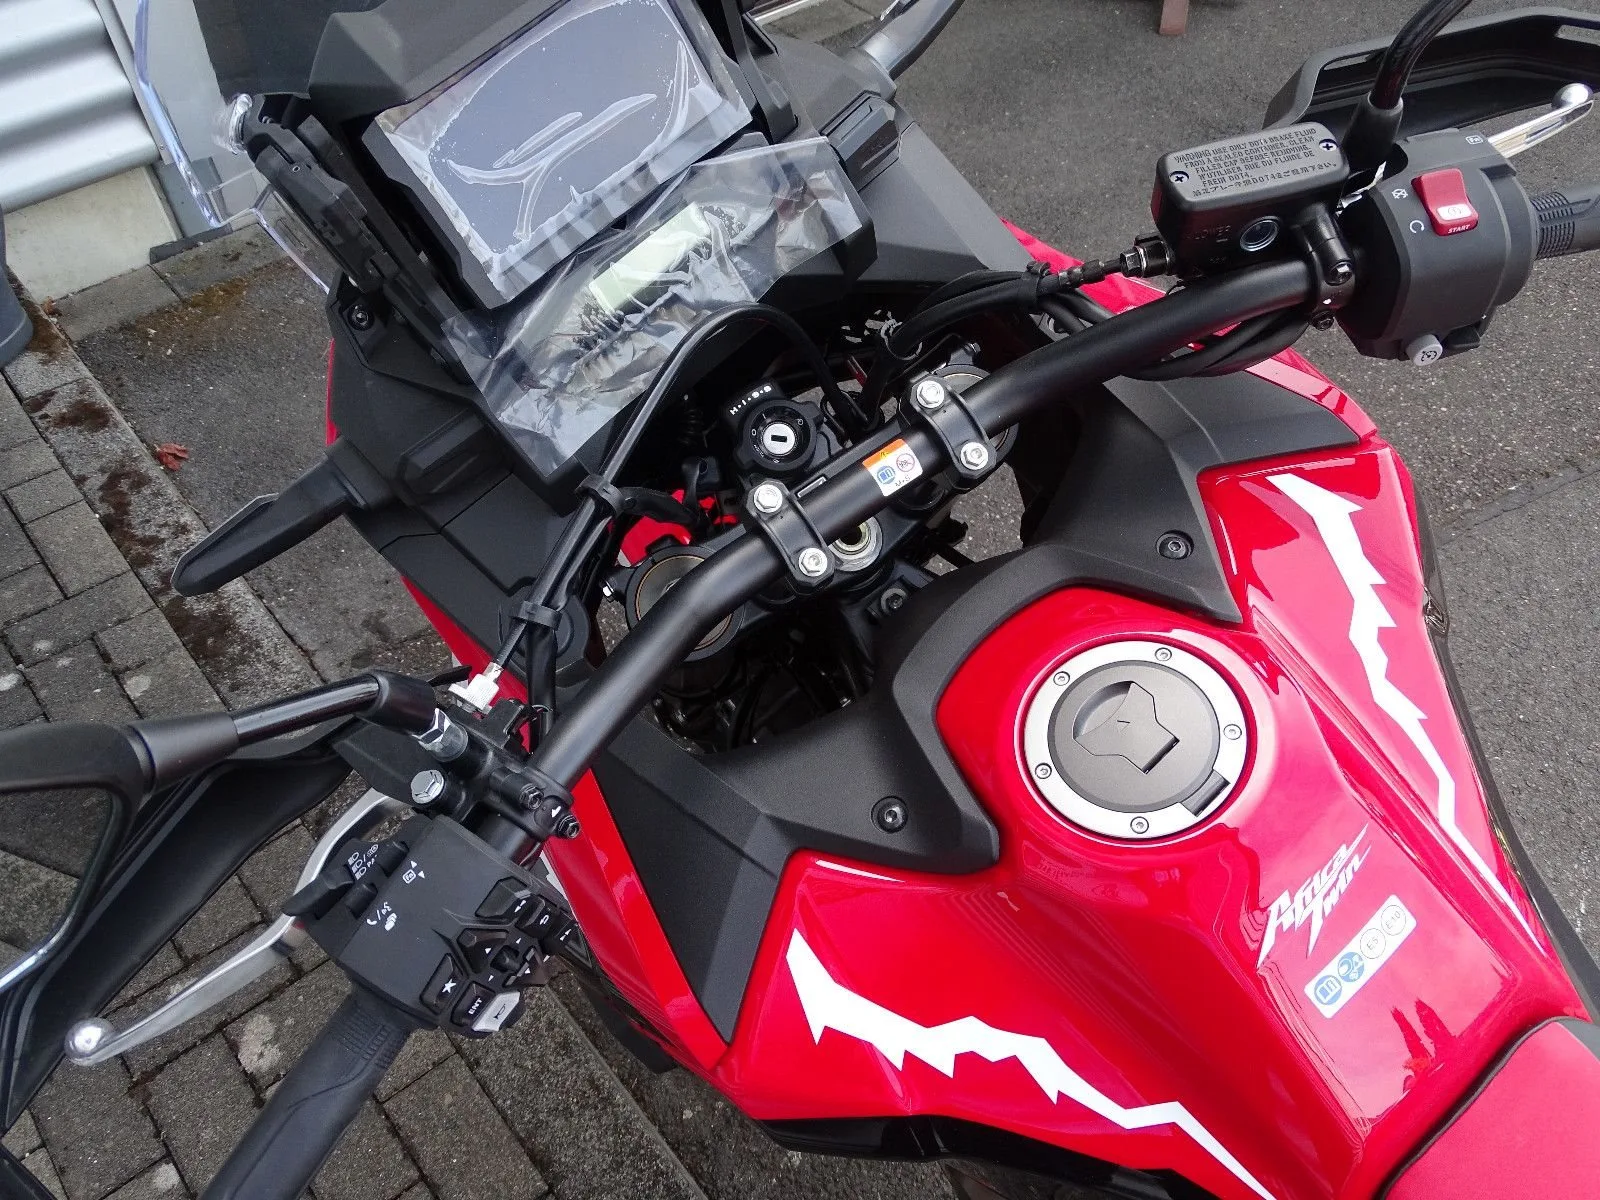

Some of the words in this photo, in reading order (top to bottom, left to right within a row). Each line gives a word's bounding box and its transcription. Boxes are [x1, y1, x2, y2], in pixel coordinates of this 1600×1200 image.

[1294, 127, 1317, 137] FLUID
[1448, 224, 1470, 234] START
[468, 997, 482, 1015] ENT
